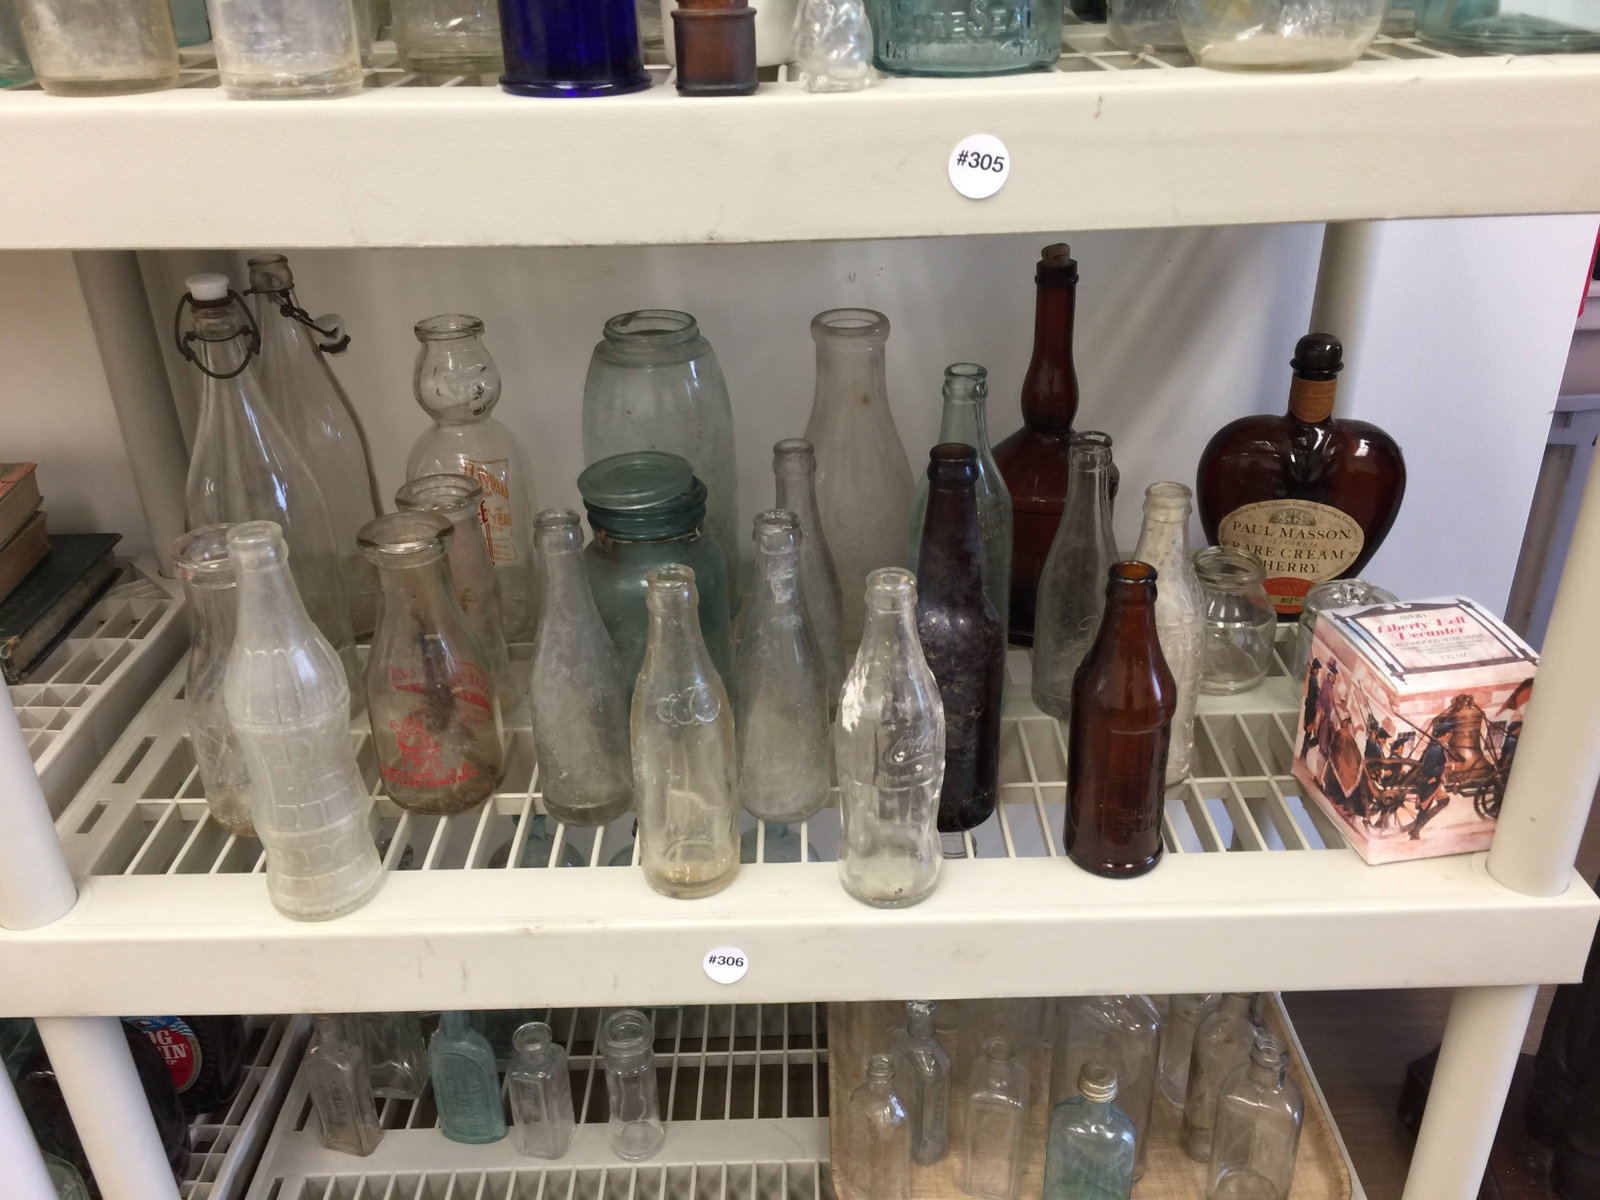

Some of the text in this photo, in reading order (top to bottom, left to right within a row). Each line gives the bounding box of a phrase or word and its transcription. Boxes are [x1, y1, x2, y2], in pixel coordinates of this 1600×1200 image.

[957, 150, 1005, 173] #305
[1233, 521, 1273, 537] PAUL
[1280, 550, 1344, 560] CREAM
[1264, 560, 1320, 573] HERRY.
[1377, 616, 1466, 633] Liberty Bell
[1396, 627, 1465, 640] Decanter
[709, 955, 744, 967] #306
